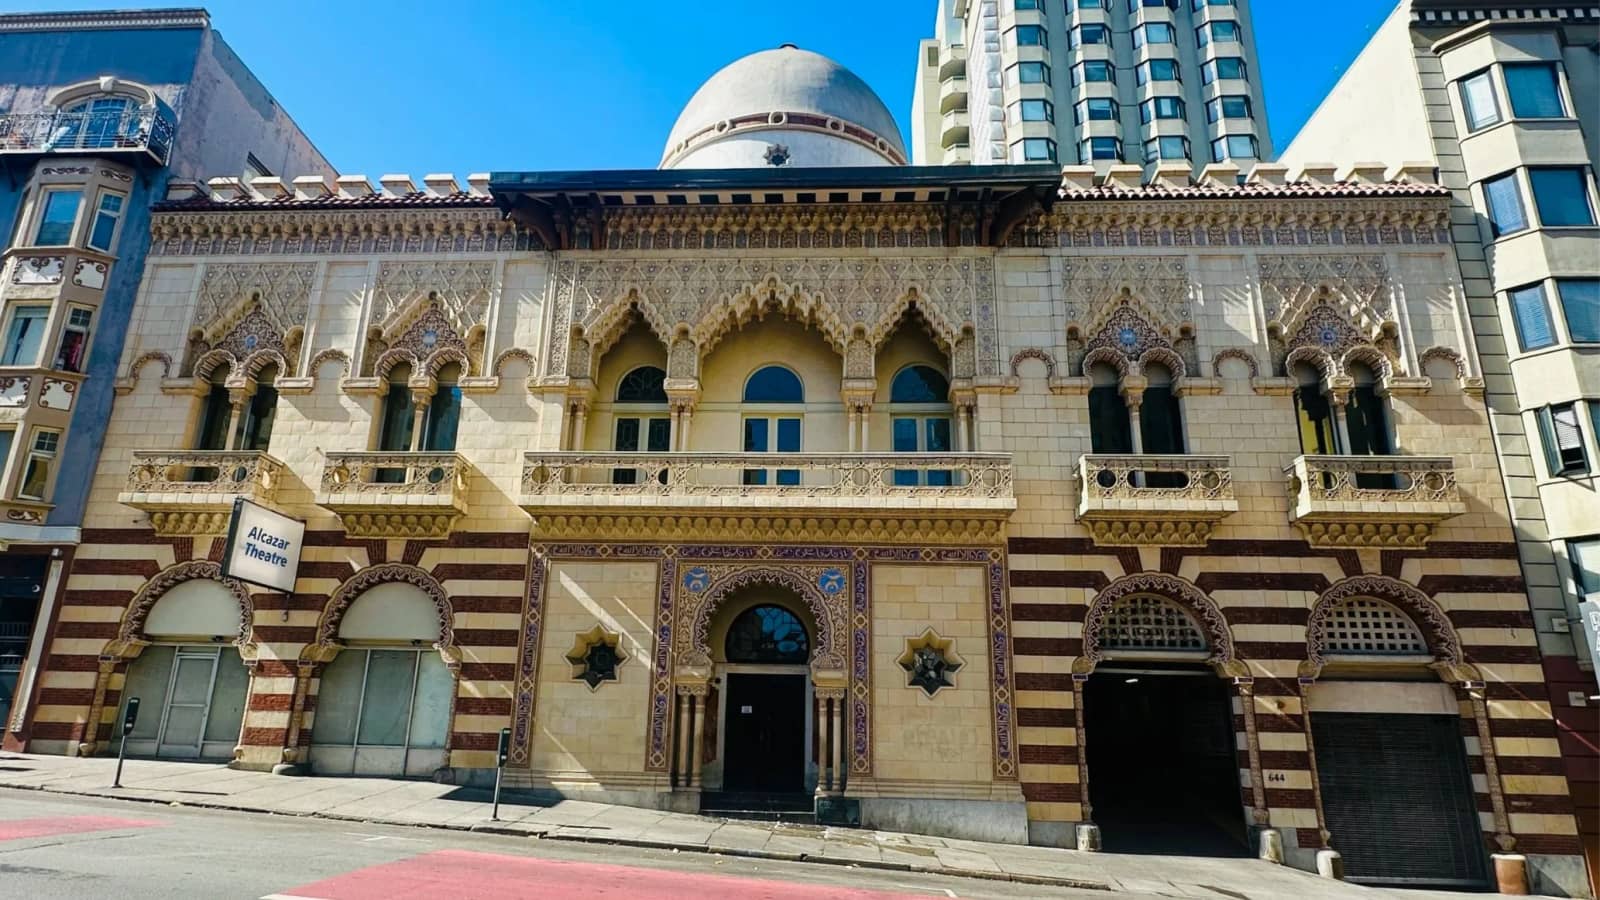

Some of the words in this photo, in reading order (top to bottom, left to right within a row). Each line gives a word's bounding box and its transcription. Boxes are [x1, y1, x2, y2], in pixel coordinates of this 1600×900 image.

[248, 526, 290, 550] Alcazar
[245, 542, 288, 567] Theatre
[1268, 773, 1285, 782] 644
